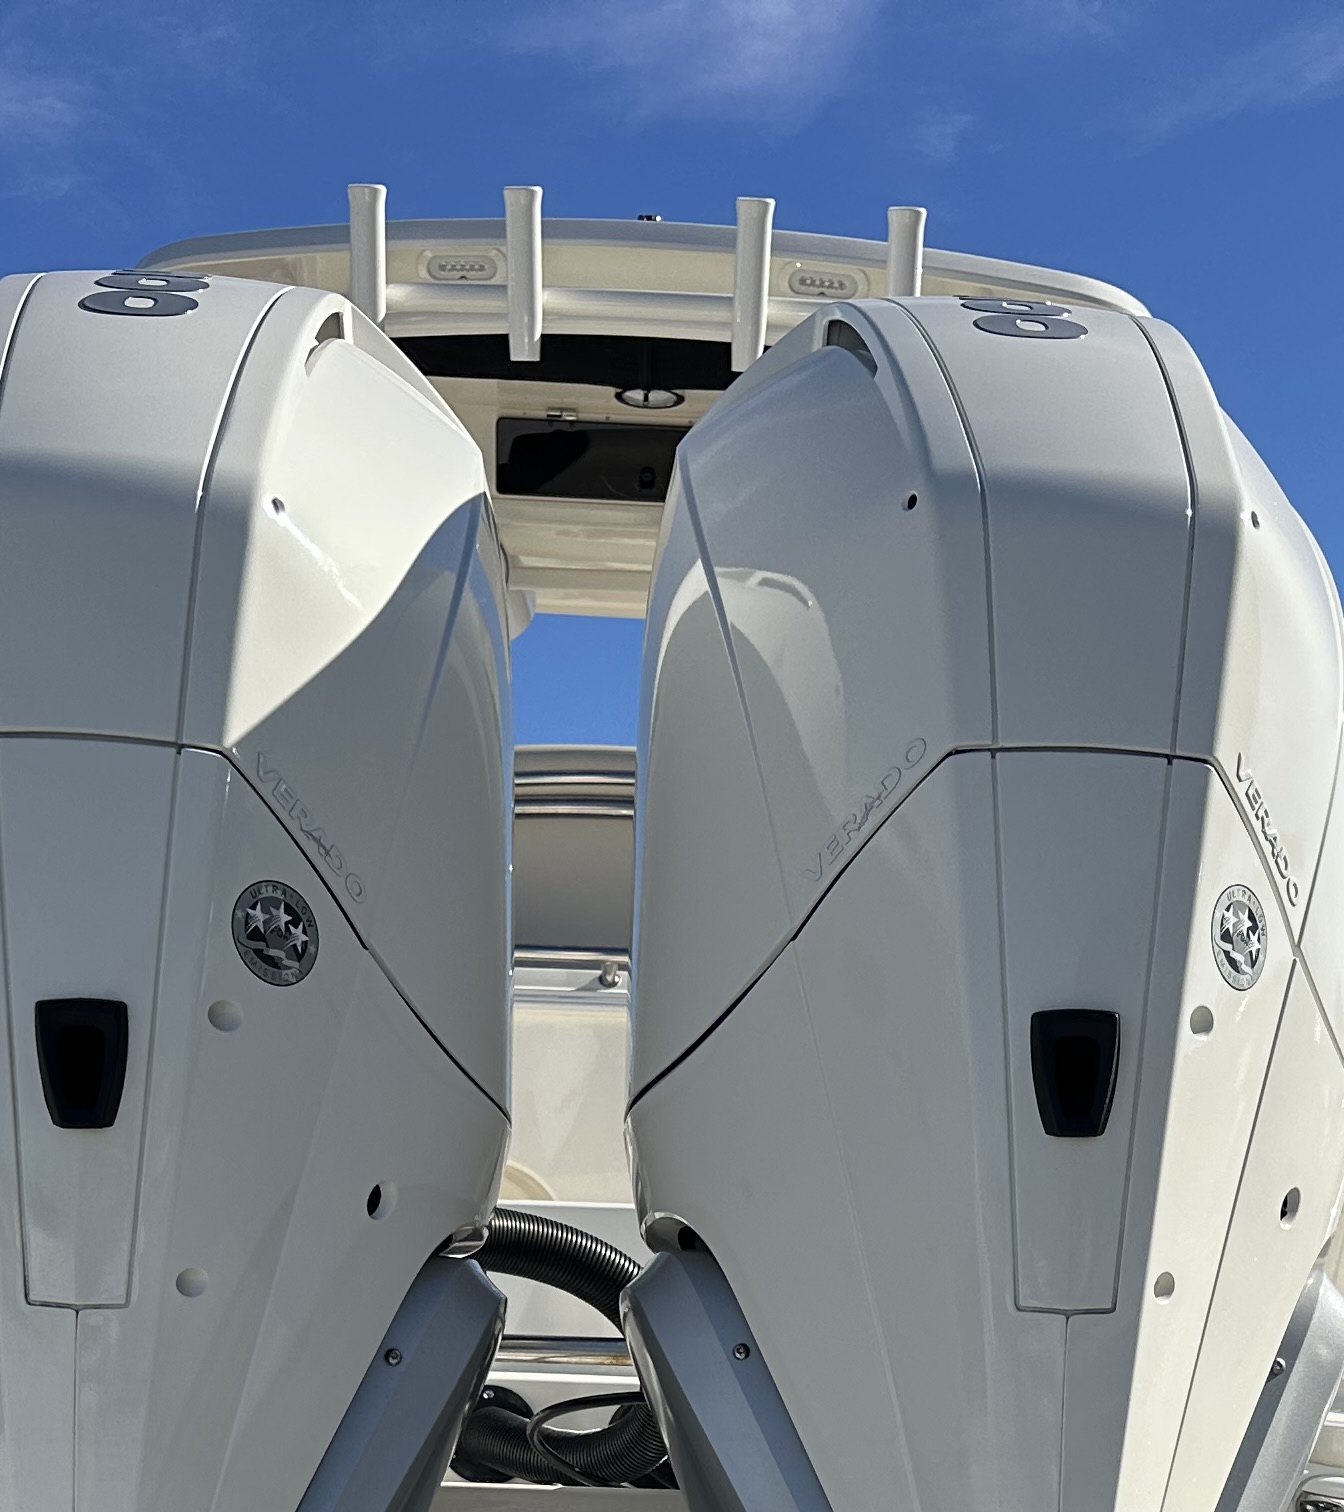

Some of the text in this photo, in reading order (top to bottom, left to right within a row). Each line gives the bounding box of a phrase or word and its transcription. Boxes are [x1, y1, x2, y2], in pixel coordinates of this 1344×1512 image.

[257, 752, 367, 904] VERADO
[799, 738, 927, 882] VERADO
[1235, 752, 1299, 907] VERADO
